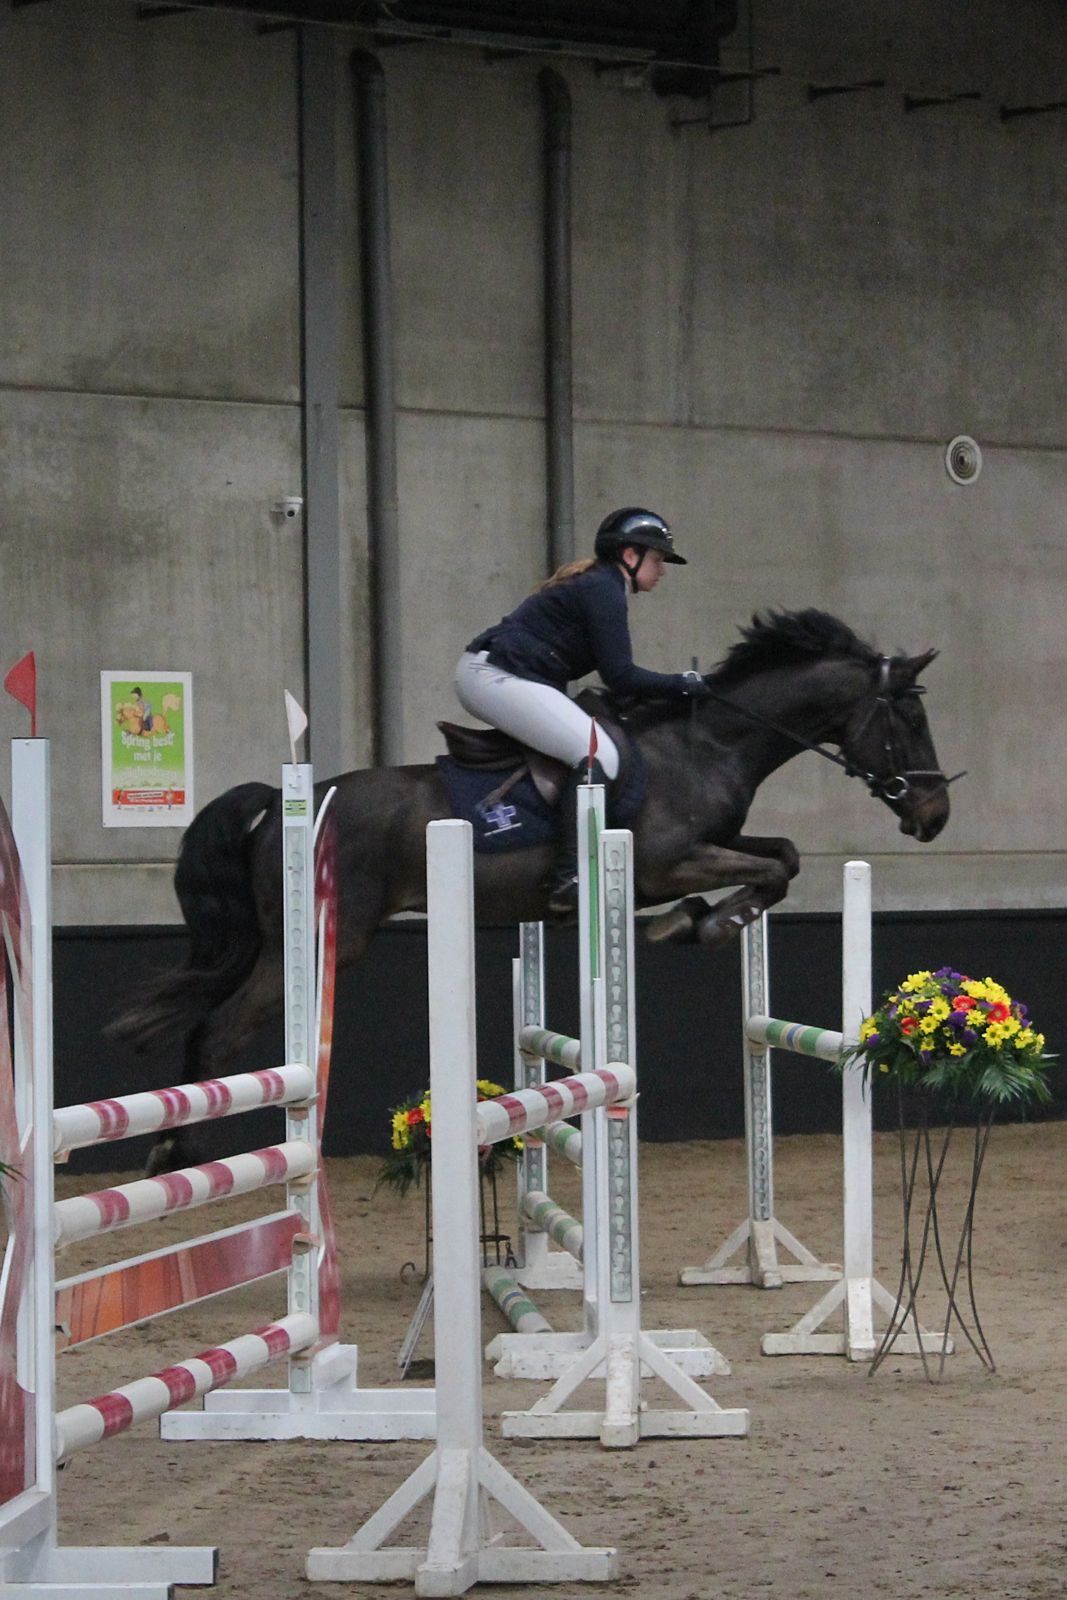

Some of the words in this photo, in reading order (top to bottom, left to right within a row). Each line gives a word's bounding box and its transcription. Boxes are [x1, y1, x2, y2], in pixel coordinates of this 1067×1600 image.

[121, 731, 151, 751] Spring
[133, 751, 151, 761] met
[153, 750, 162, 764] je
